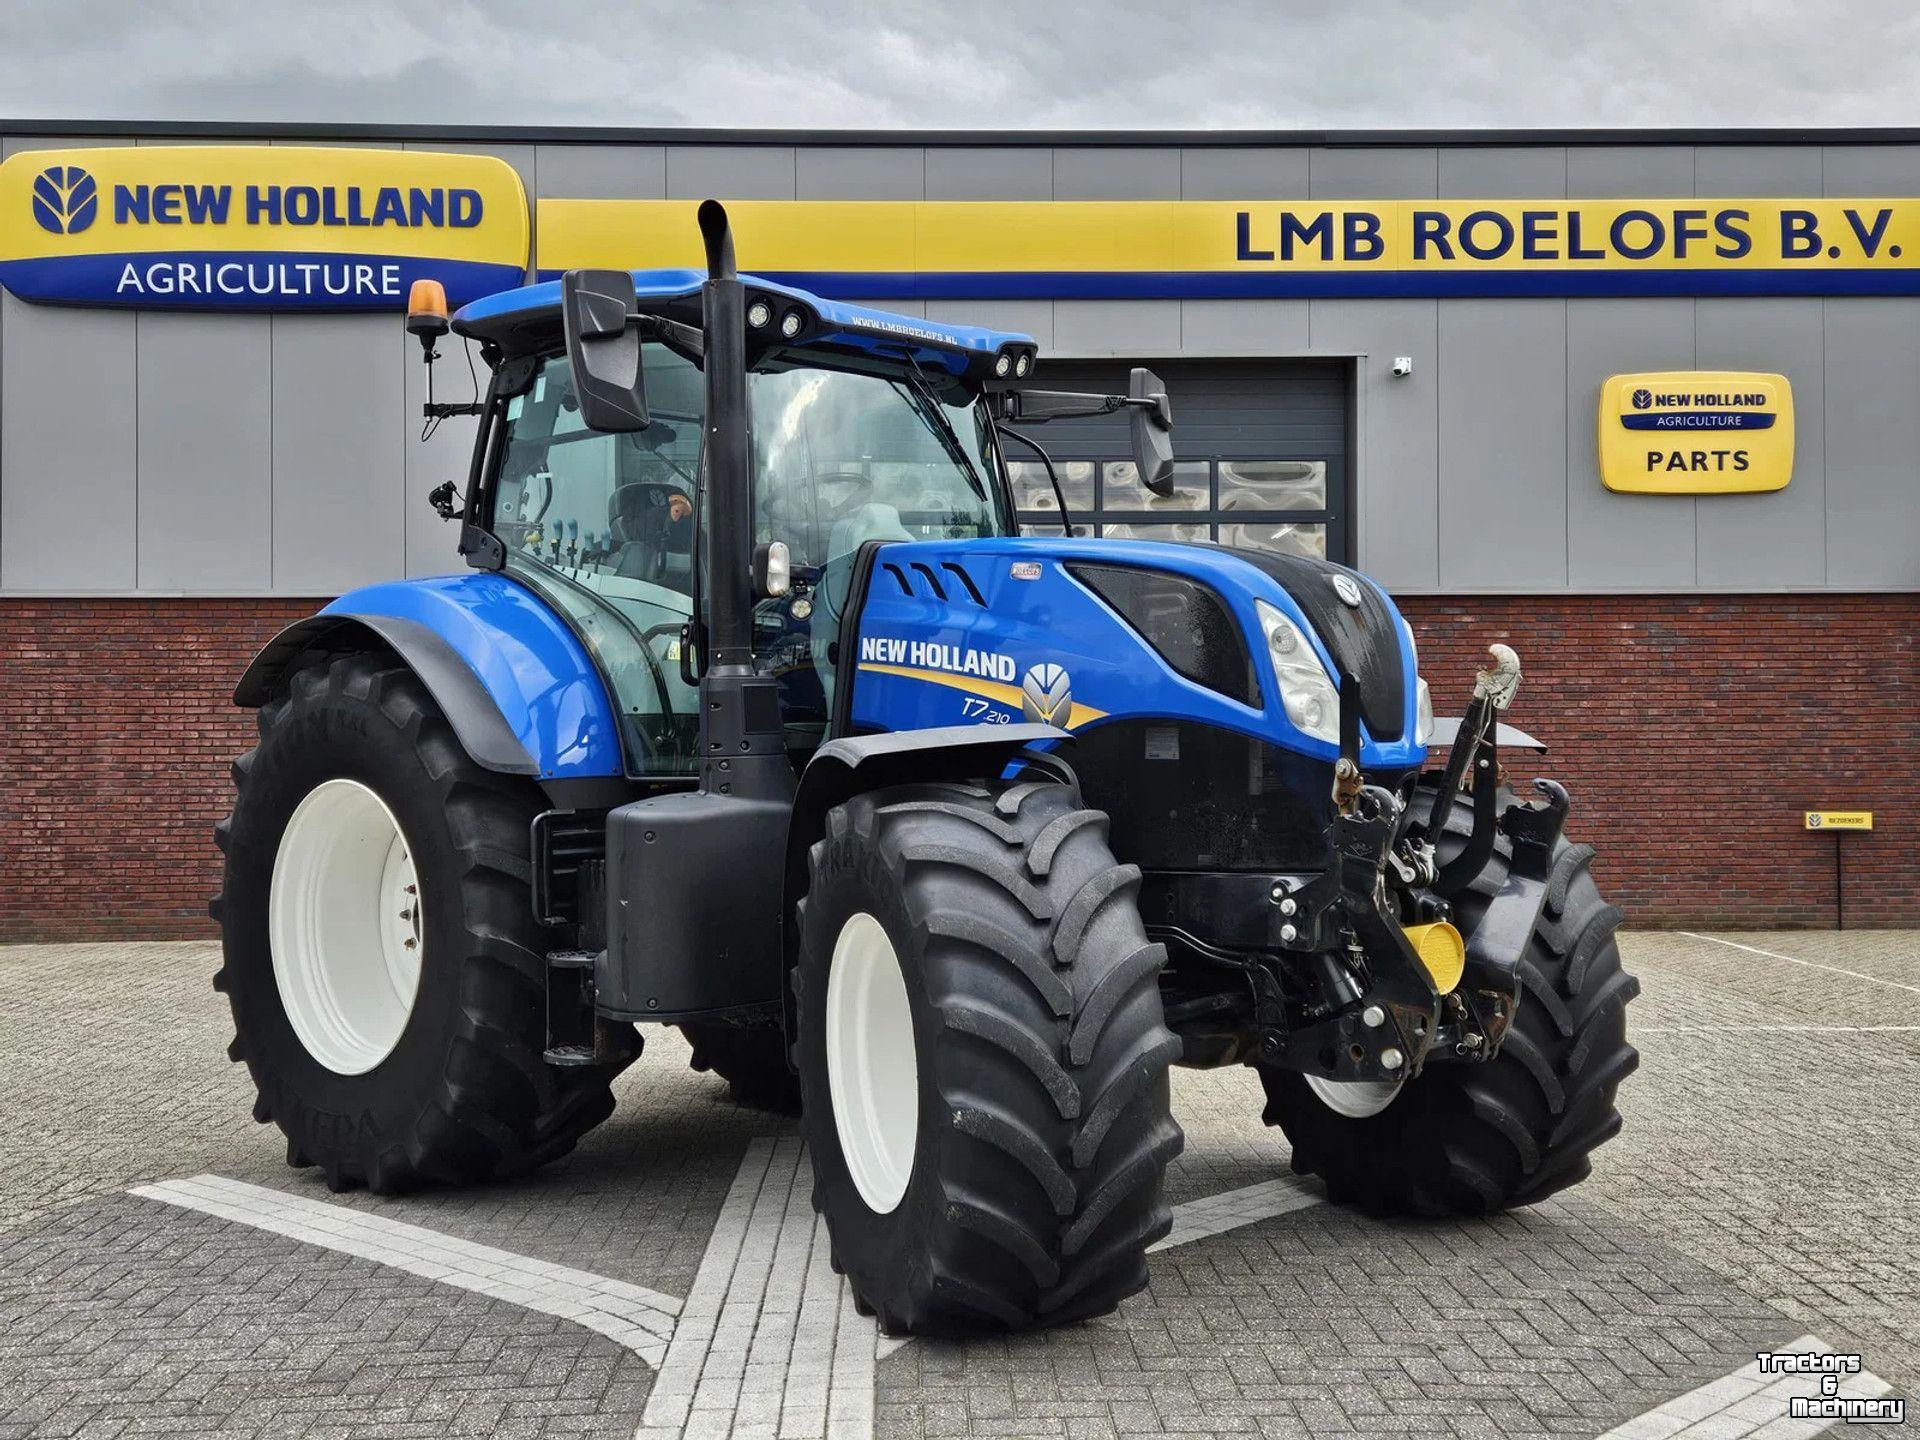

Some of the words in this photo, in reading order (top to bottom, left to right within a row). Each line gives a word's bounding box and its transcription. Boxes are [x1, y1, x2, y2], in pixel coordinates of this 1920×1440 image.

[114, 184, 232, 225] NEW
[246, 185, 484, 228] HOLLAND
[1236, 211, 1385, 261] LMB
[1413, 209, 1752, 261] ROELOFS
[1780, 209, 1903, 260] B.V.
[116, 262, 400, 296] AGRICULTURE
[851, 316, 958, 345] WWW.LMBROELOFS.NL
[1655, 393, 1691, 407] NEW
[1694, 393, 1767, 407] HOLLAND
[1656, 415, 1742, 427] AGRICULTURE
[1647, 450, 1750, 472] PARTS
[861, 637, 907, 663] NEW
[911, 641, 1017, 682] HOLLAND
